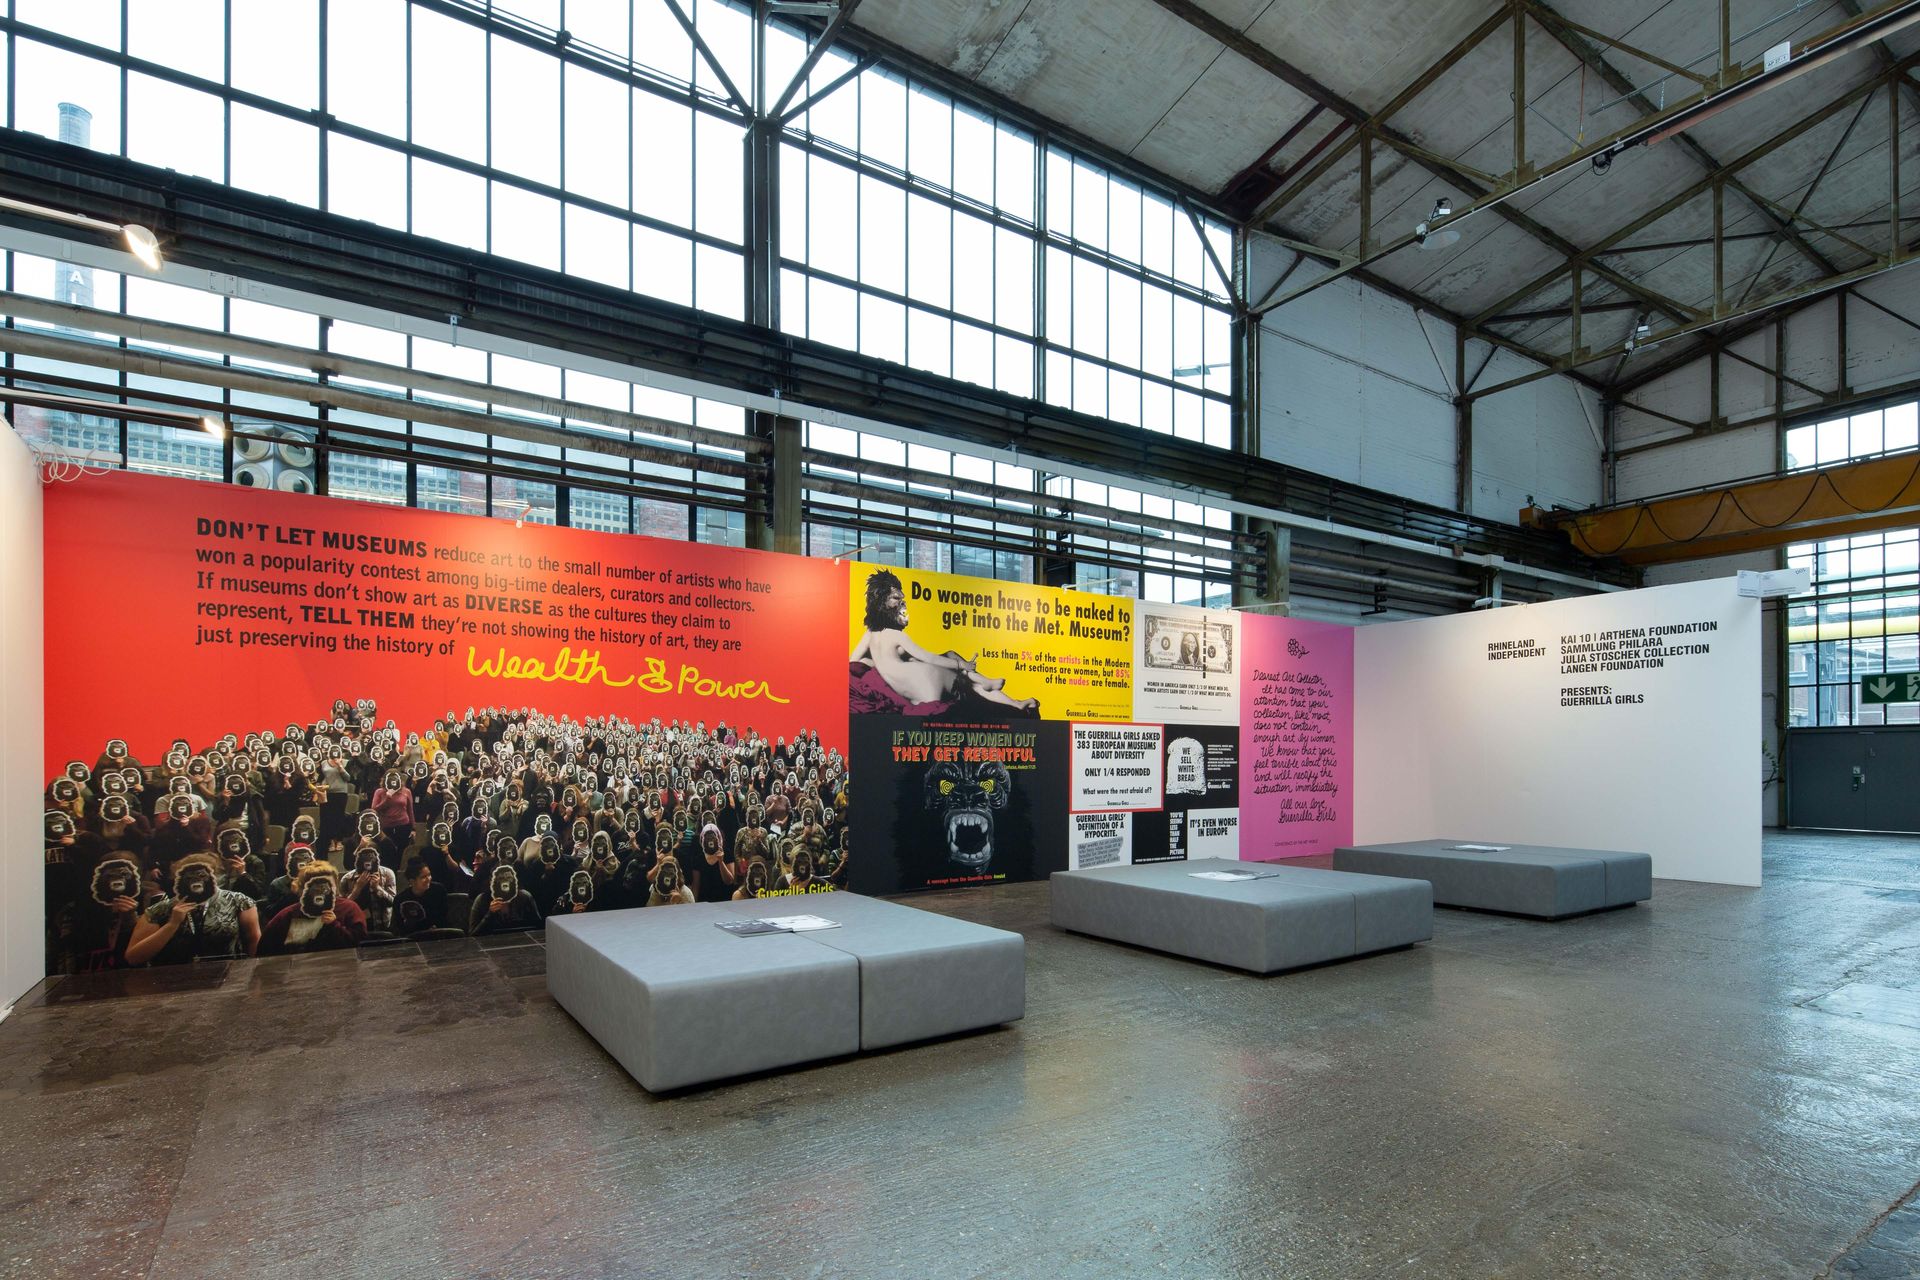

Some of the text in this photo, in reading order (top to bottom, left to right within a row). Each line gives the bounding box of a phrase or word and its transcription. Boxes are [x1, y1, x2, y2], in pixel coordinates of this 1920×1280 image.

[196, 518, 772, 594] DON'T LET MUSEUMS reduce art to the small number of artists who have
[196, 571, 730, 630] If museums don't show art as DIVERSE as the cultures they claim to
[912, 581, 1130, 624] Do women have to be naked to
[942, 608, 1130, 642] get into the Met. Museum?
[1561, 634, 1576, 644] KAI
[1580, 633, 1591, 643] 10
[1600, 628, 1646, 641] ARTHENA
[1649, 621, 1717, 636] FOUNDATION
[196, 625, 455, 657] just preserving the history of
[1488, 639, 1535, 651] RHINELAND
[1561, 638, 1663, 654] SAMMLUNG PHILARA
[982, 648, 1130, 668] Less than 5% of the artists in the Modern
[1488, 648, 1546, 661] INDEPENDENT
[1561, 644, 1710, 664] JULIA STOSCHEK COLLECTION
[1015, 662, 1026, 671] Art
[1028, 663, 1057, 674] sections
[1074, 668, 1100, 678] women,
[1102, 668, 1114, 677] but
[1115, 668, 1130, 679] 85%
[1561, 659, 1664, 674] LANGEN FOUNDATION
[467, 646, 634, 686] Wealth
[678, 664, 790, 704] Power
[1046, 674, 1052, 684] of
[1055, 674, 1066, 684] the
[1068, 676, 1090, 686] nudes
[1104, 678, 1130, 688] female.
[1561, 686, 1612, 696] PRESENTS:
[1561, 694, 1644, 707] GUERRILLA GIRLS
[892, 731, 1036, 747] IF YOU KEEP WOMEN OUT
[1074, 731, 1086, 739] THE
[1088, 731, 1121, 740] GUERRILLA
[1124, 732, 1140, 740] GIRLS
[1077, 741, 1156, 750] 383 EUROPEAN MUSEUMS
[892, 746, 1036, 762] THEY GET RESENTFUL
[1091, 751, 1145, 759] ABOUT DIVERSITY
[1085, 768, 1150, 776] ONLY 1/4 RESPONDED
[1076, 814, 1106, 822] GUERRILLA
[1190, 818, 1237, 828] IT'S EVEN WORSE
[1078, 822, 1110, 830] DEFINITION
[1198, 827, 1228, 837] IN EUROPE
[1085, 830, 1117, 838] HYPOCRITE.
[758, 883, 834, 898] Guerrilla Girls
